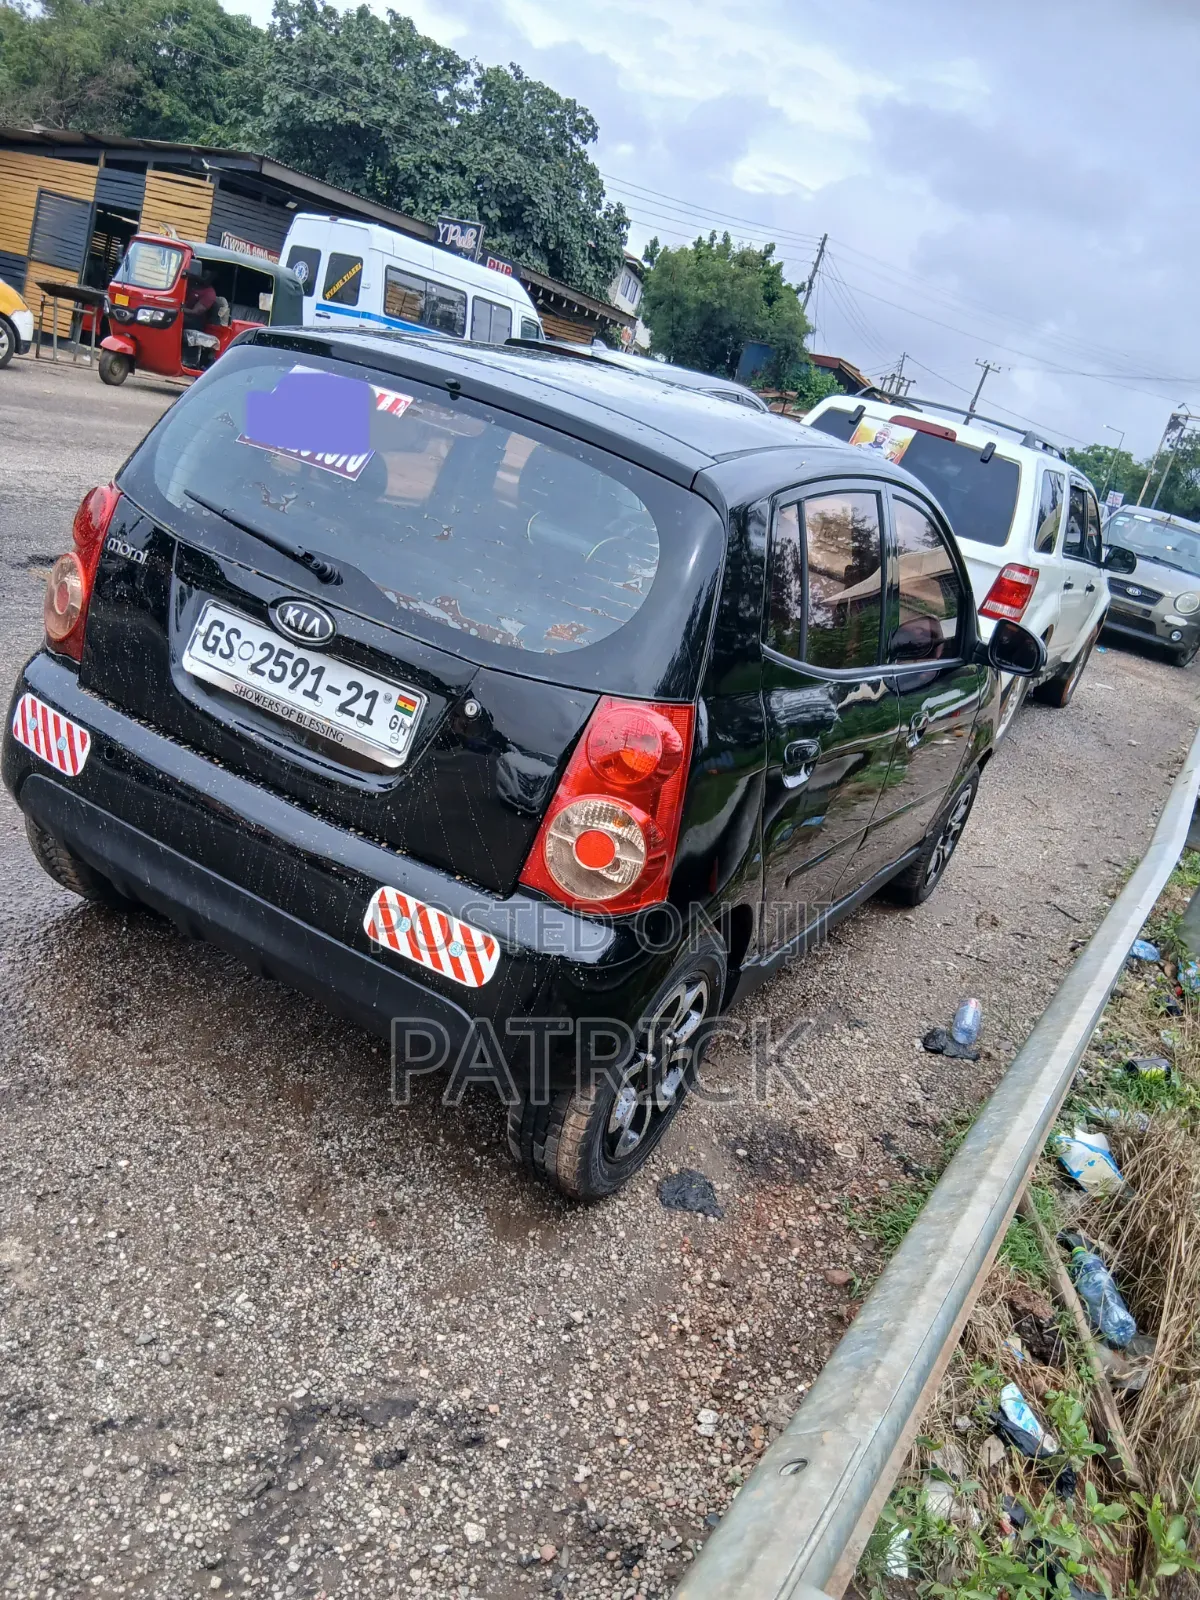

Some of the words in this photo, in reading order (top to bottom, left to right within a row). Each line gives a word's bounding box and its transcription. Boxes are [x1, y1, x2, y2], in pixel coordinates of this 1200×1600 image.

[282, 605, 321, 639] KIA
[232, 683, 281, 713] SHOWERS
[281, 706, 297, 719] OF
[297, 712, 345, 743] BLESSING
[248, 641, 380, 726] 2591-21
